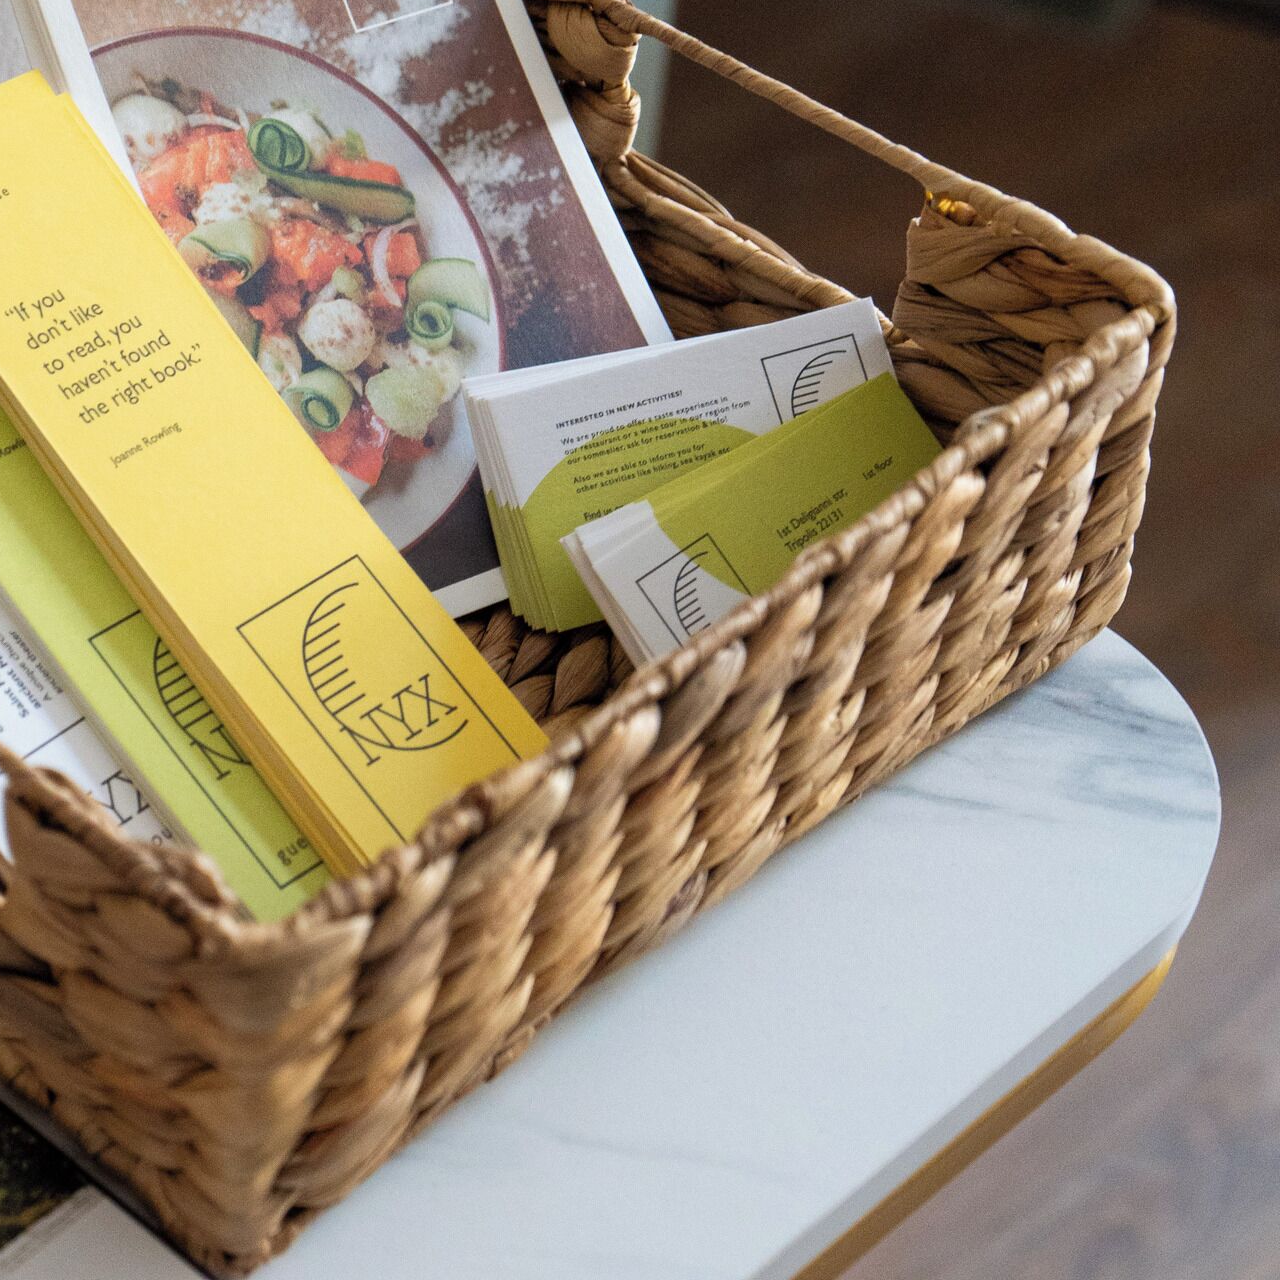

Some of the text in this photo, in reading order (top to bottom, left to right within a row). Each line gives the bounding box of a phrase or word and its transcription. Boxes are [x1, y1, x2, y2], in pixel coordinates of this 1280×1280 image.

[32, 288, 66, 318] you
[26, 301, 104, 350] don’t like
[43, 315, 142, 376] to read, you
[58, 329, 170, 400] haven’t found
[78, 402, 109, 424] the
[111, 378, 153, 406] right
[555, 389, 682, 429] INTERESTED IN NEW ACTIVITIES!
[560, 436, 574, 445] We
[575, 433, 589, 442] are
[590, 425, 615, 439] proud
[615, 424, 625, 432] to
[626, 417, 645, 428] offer
[653, 410, 674, 422] taste
[675, 398, 718, 414] experience
[110, 421, 182, 468] Joanne Rowling
[563, 400, 750, 455] our restaurant wine tour our region from
[566, 456, 581, 465] our
[582, 444, 626, 461] sommelier,
[626, 439, 640, 449] ask
[640, 436, 653, 444] for
[654, 424, 700, 441] reservation
[708, 415, 728, 426] info!
[572, 443, 705, 484] Also we are able to inform you for
[874, 456, 892, 471] floor
[784, 508, 842, 551] Tripolis 22131
[790, 497, 831, 528] Deligianni
[6, 668, 41, 708] ancient
[18, 661, 44, 691] unique
[3, 687, 29, 718] Saint
[339, 673, 458, 766] NYX
